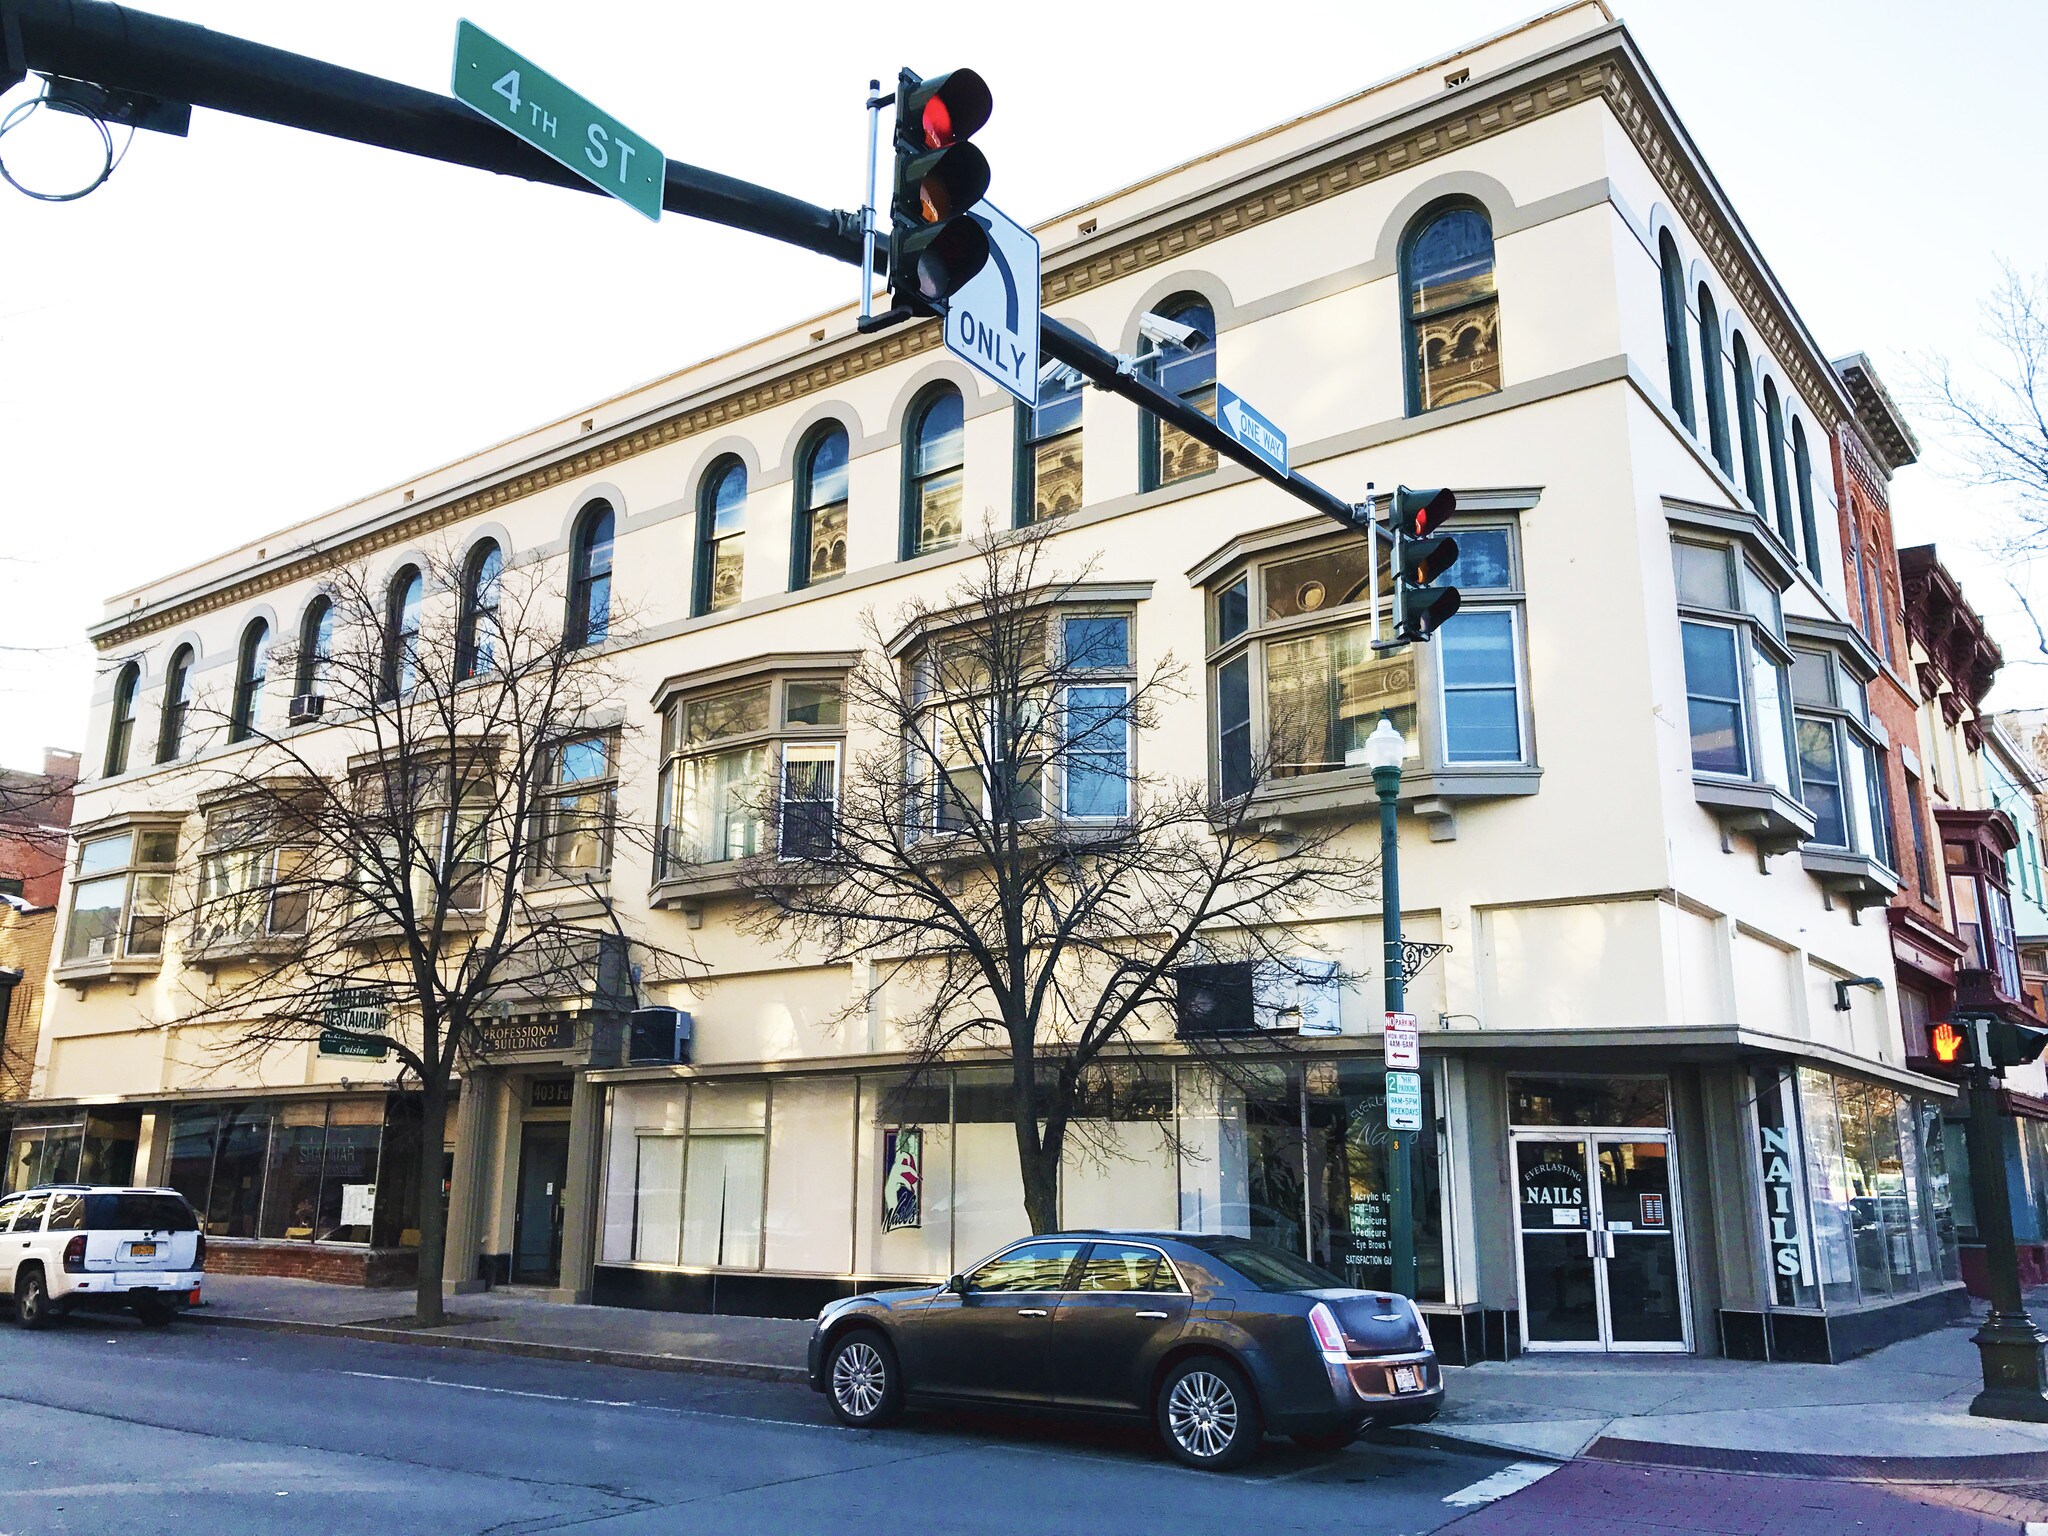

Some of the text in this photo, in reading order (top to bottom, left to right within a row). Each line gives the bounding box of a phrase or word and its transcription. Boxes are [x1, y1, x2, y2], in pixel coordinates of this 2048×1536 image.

[491, 69, 636, 184] 4TH ST
[960, 310, 1026, 380] ONLY
[1240, 414, 1281, 458] ONE WAY
[324, 1009, 389, 1030] RESTAURANT
[1385, 1016, 1416, 1028] NO PARKING
[483, 1024, 560, 1041] PROFESSIONAL
[339, 1044, 369, 1055] Cuisine
[494, 1036, 547, 1050] BUILDING
[1388, 1076, 1412, 1091] 2 HR
[1398, 1084, 1418, 1093] PARKING
[534, 1085, 554, 1101] 403
[1390, 1096, 1418, 1106] 9AM-5PM
[1390, 1107, 1420, 1116] WEEKDAYS
[1393, 1140, 1399, 1151] 8
[301, 1145, 355, 1162] SHAIMAR
[1524, 1163, 1582, 1183] EVERLASTING
[1354, 1192, 1379, 1203] Acrylic
[1527, 1186, 1582, 1205] NAILS
[1761, 1127, 1800, 1276] NAILS
[1354, 1203, 1380, 1213] Fill-Ins
[1354, 1216, 1387, 1226] Manicure
[1355, 1228, 1387, 1238] Pedicure
[1356, 1240, 1367, 1251] Eye
[1368, 1240, 1386, 1250] Brows
[1345, 1255, 1383, 1265] SATISFACTION
